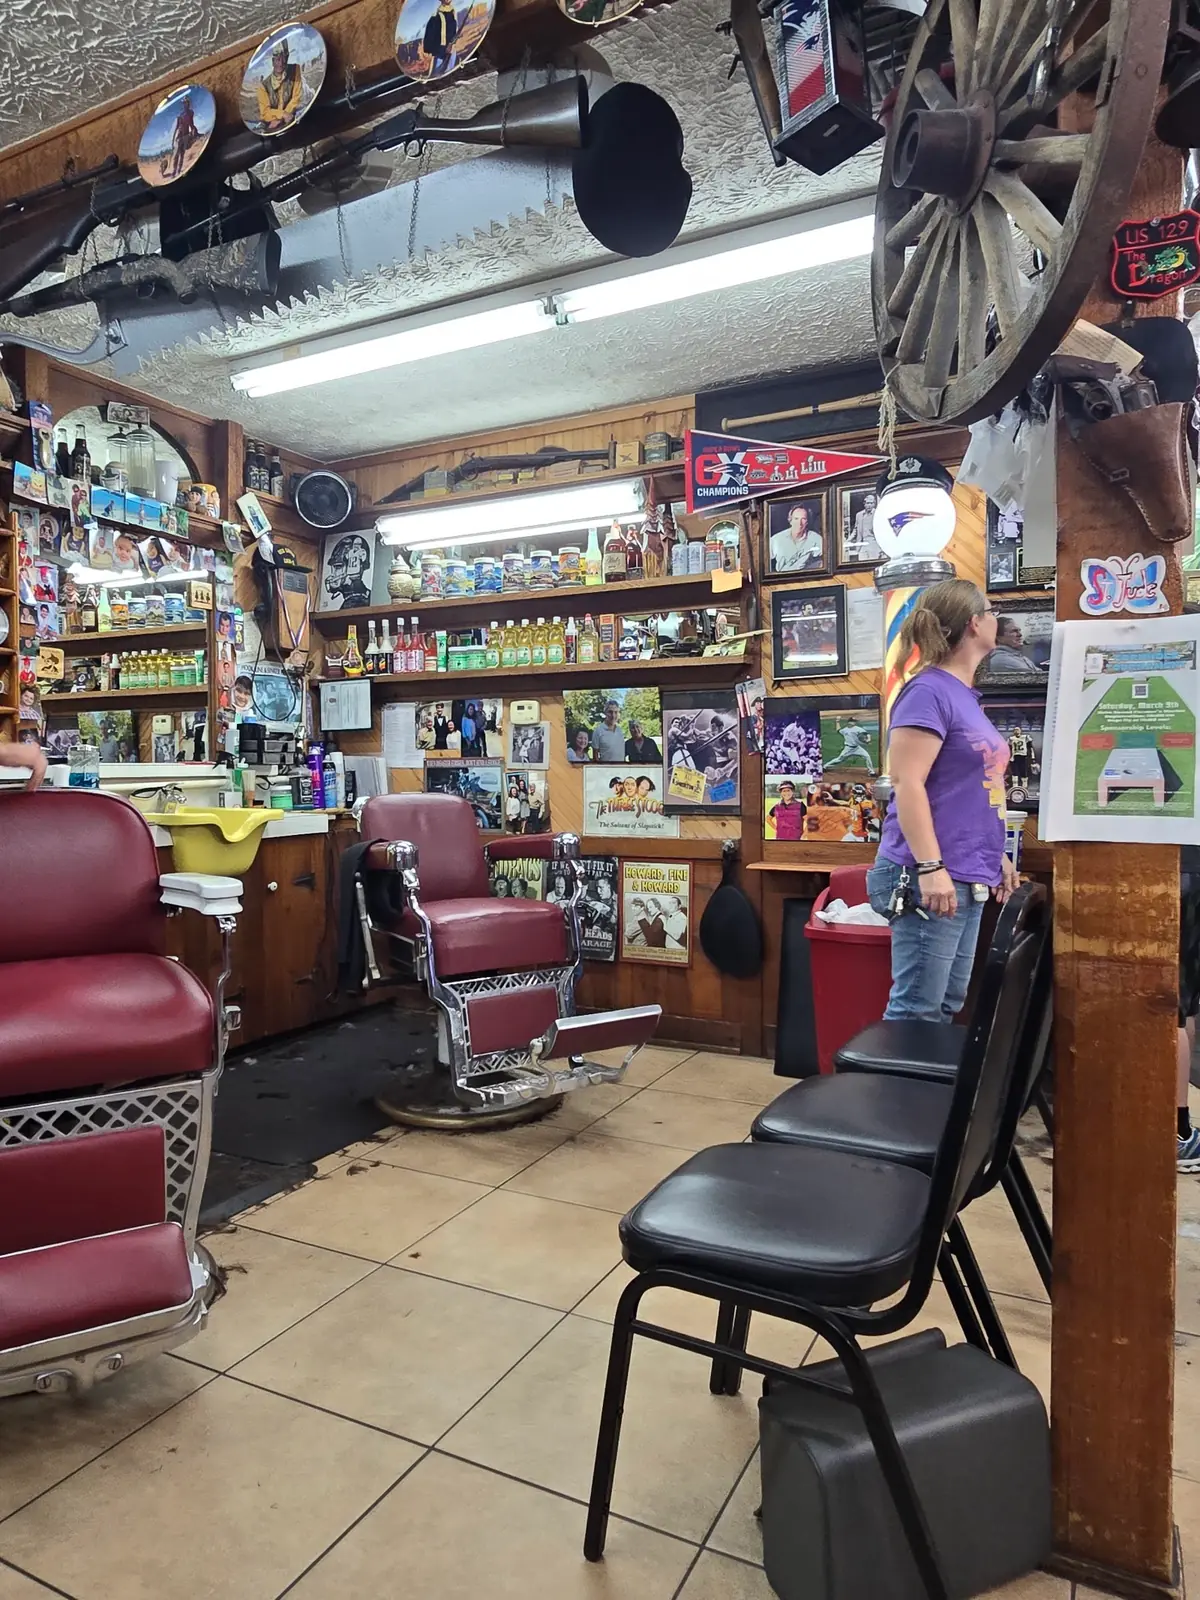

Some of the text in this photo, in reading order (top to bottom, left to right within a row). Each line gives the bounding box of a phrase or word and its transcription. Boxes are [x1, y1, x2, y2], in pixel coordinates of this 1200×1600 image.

[1126, 220, 1189, 244] US 129
[1123, 250, 1146, 262] The
[1128, 263, 1187, 287] Dragon
[697, 486, 749, 497] CHAMPIONS
[1112, 567, 1157, 608] Jude
[593, 861, 604, 871] FIX
[606, 863, 614, 872] IT
[625, 867, 688, 881] HOWARD, FINE
[632, 881, 679, 893] & HOWARD
[580, 940, 612, 948] ARAGE
